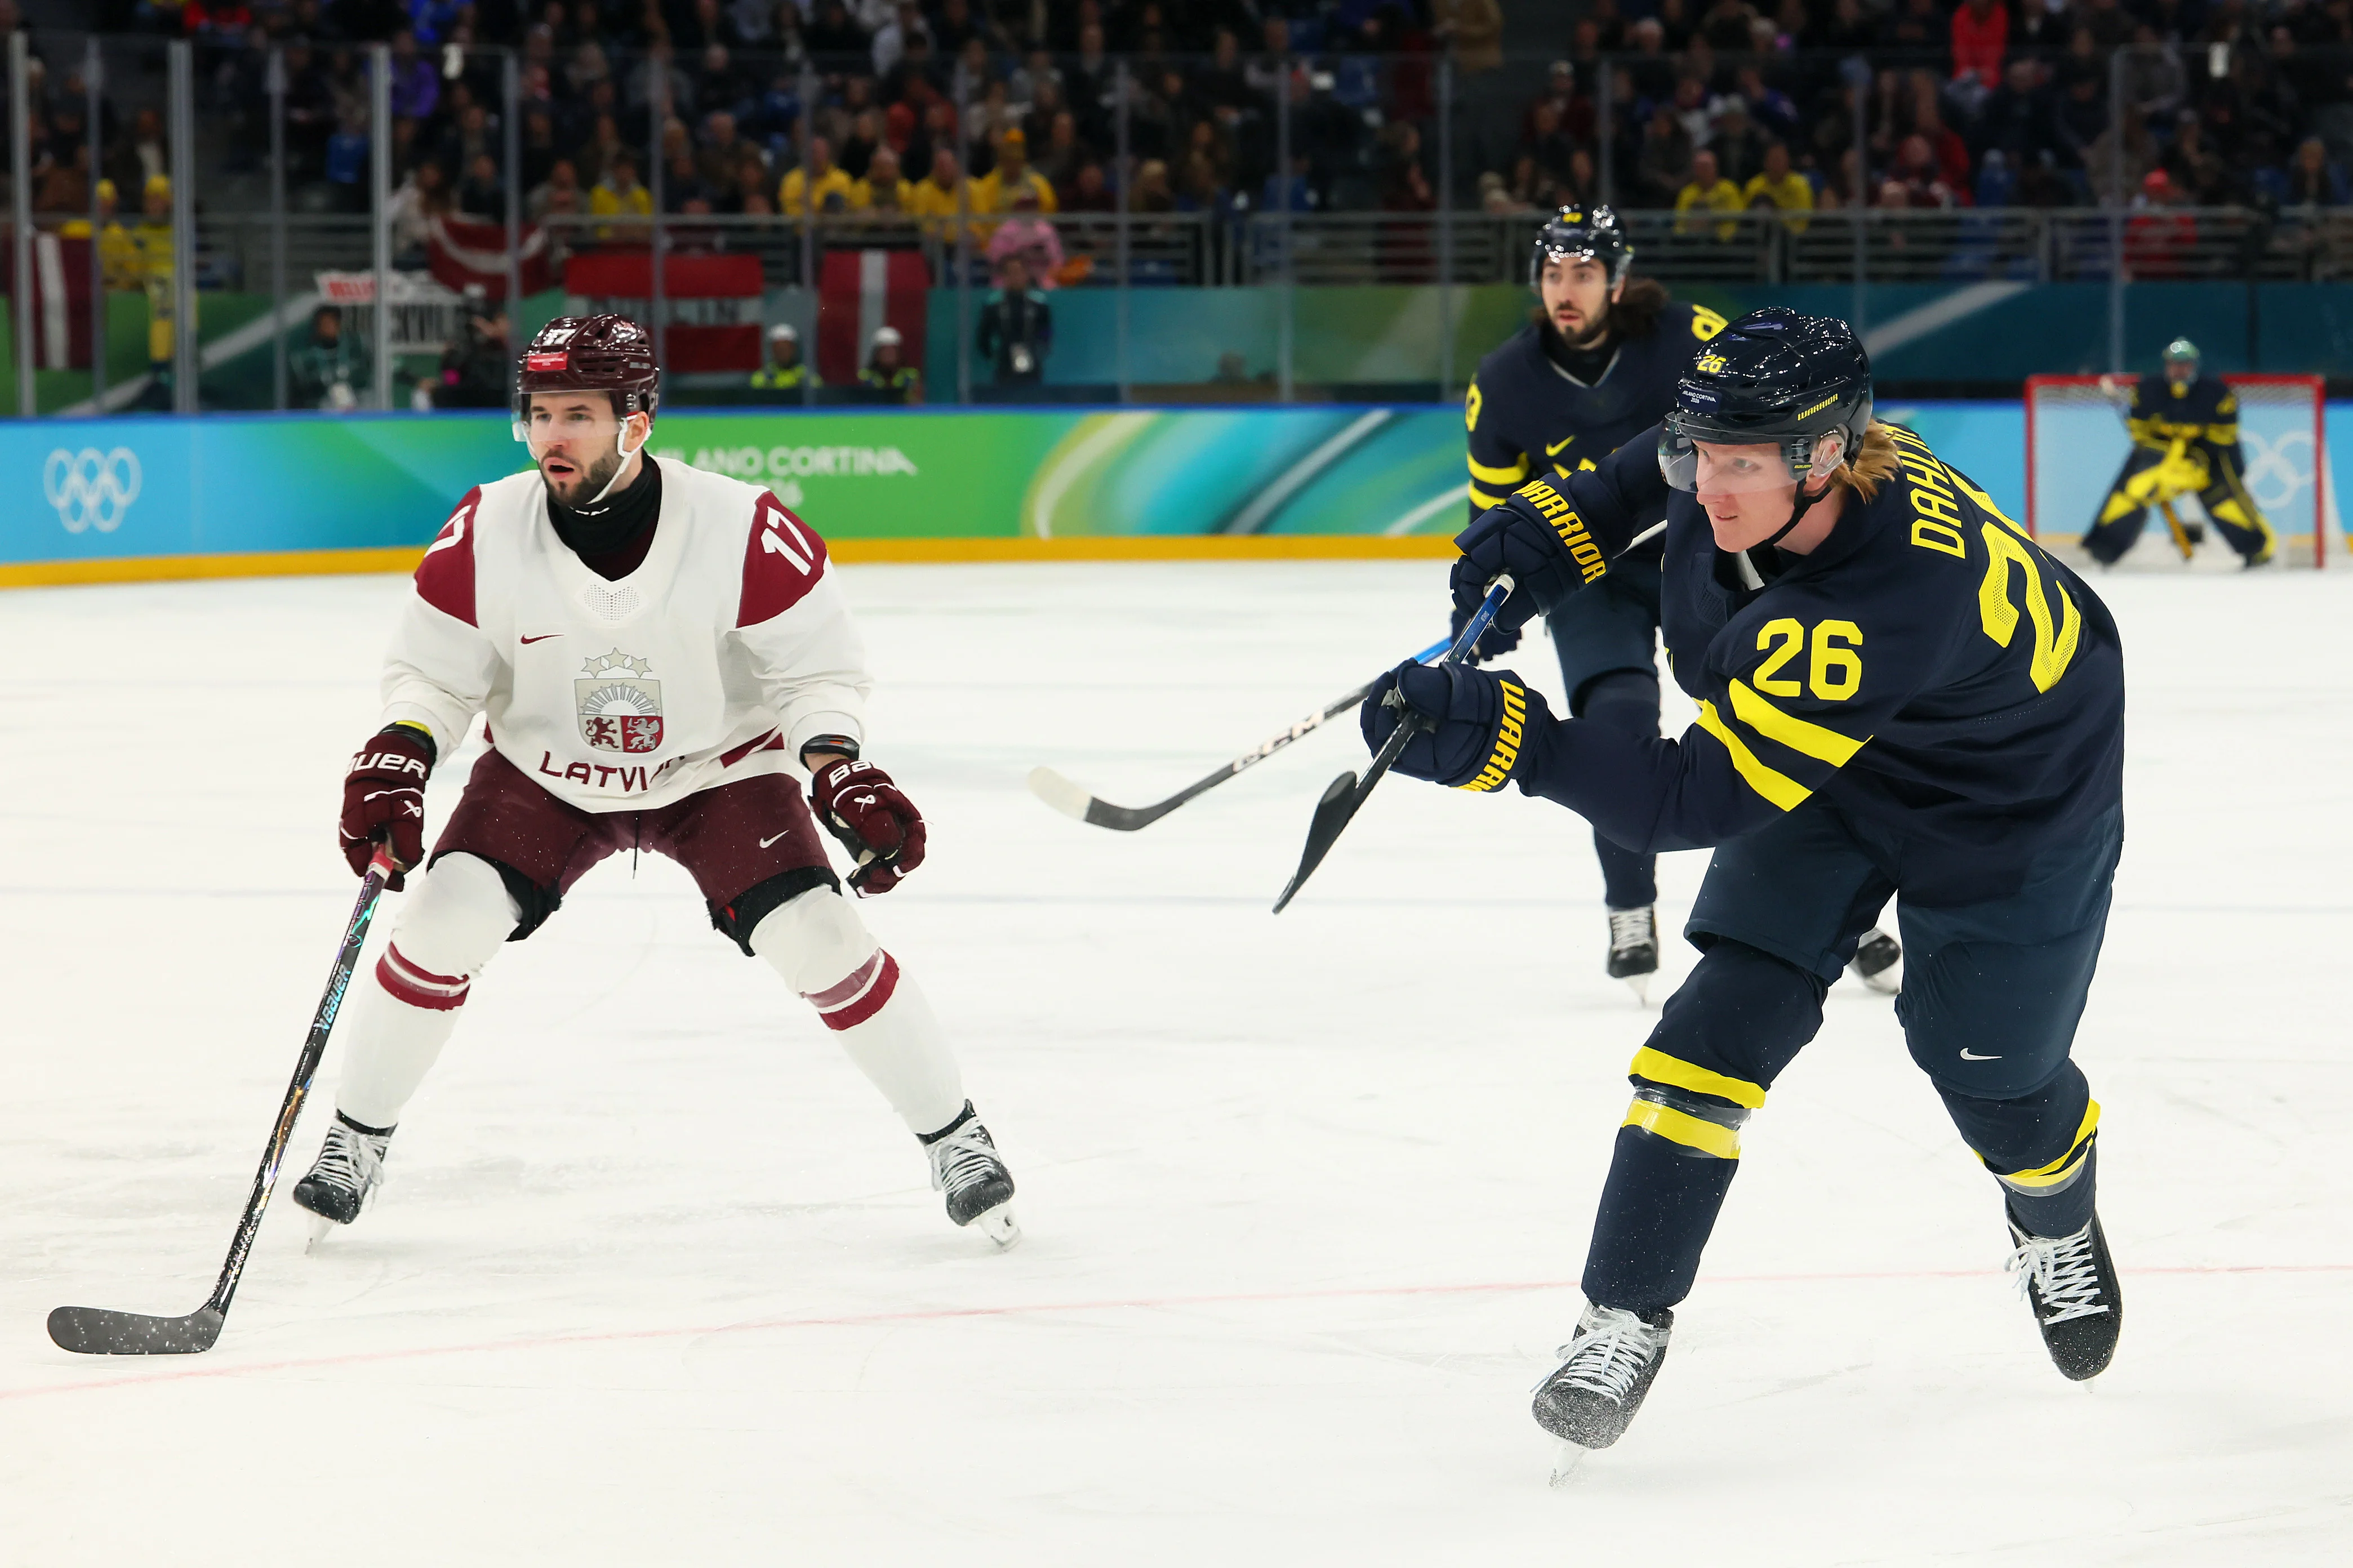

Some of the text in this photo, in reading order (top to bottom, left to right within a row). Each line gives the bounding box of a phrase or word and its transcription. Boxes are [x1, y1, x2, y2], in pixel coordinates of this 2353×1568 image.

[1697, 354, 1727, 374] 26
[1696, 393, 1716, 403] CORTINA
[1798, 393, 1838, 421] WARRIOR
[767, 447, 918, 478] CORTINA
[760, 506, 814, 576] 17
[1753, 617, 1863, 701] 26
[1232, 710, 1325, 773] CCM
